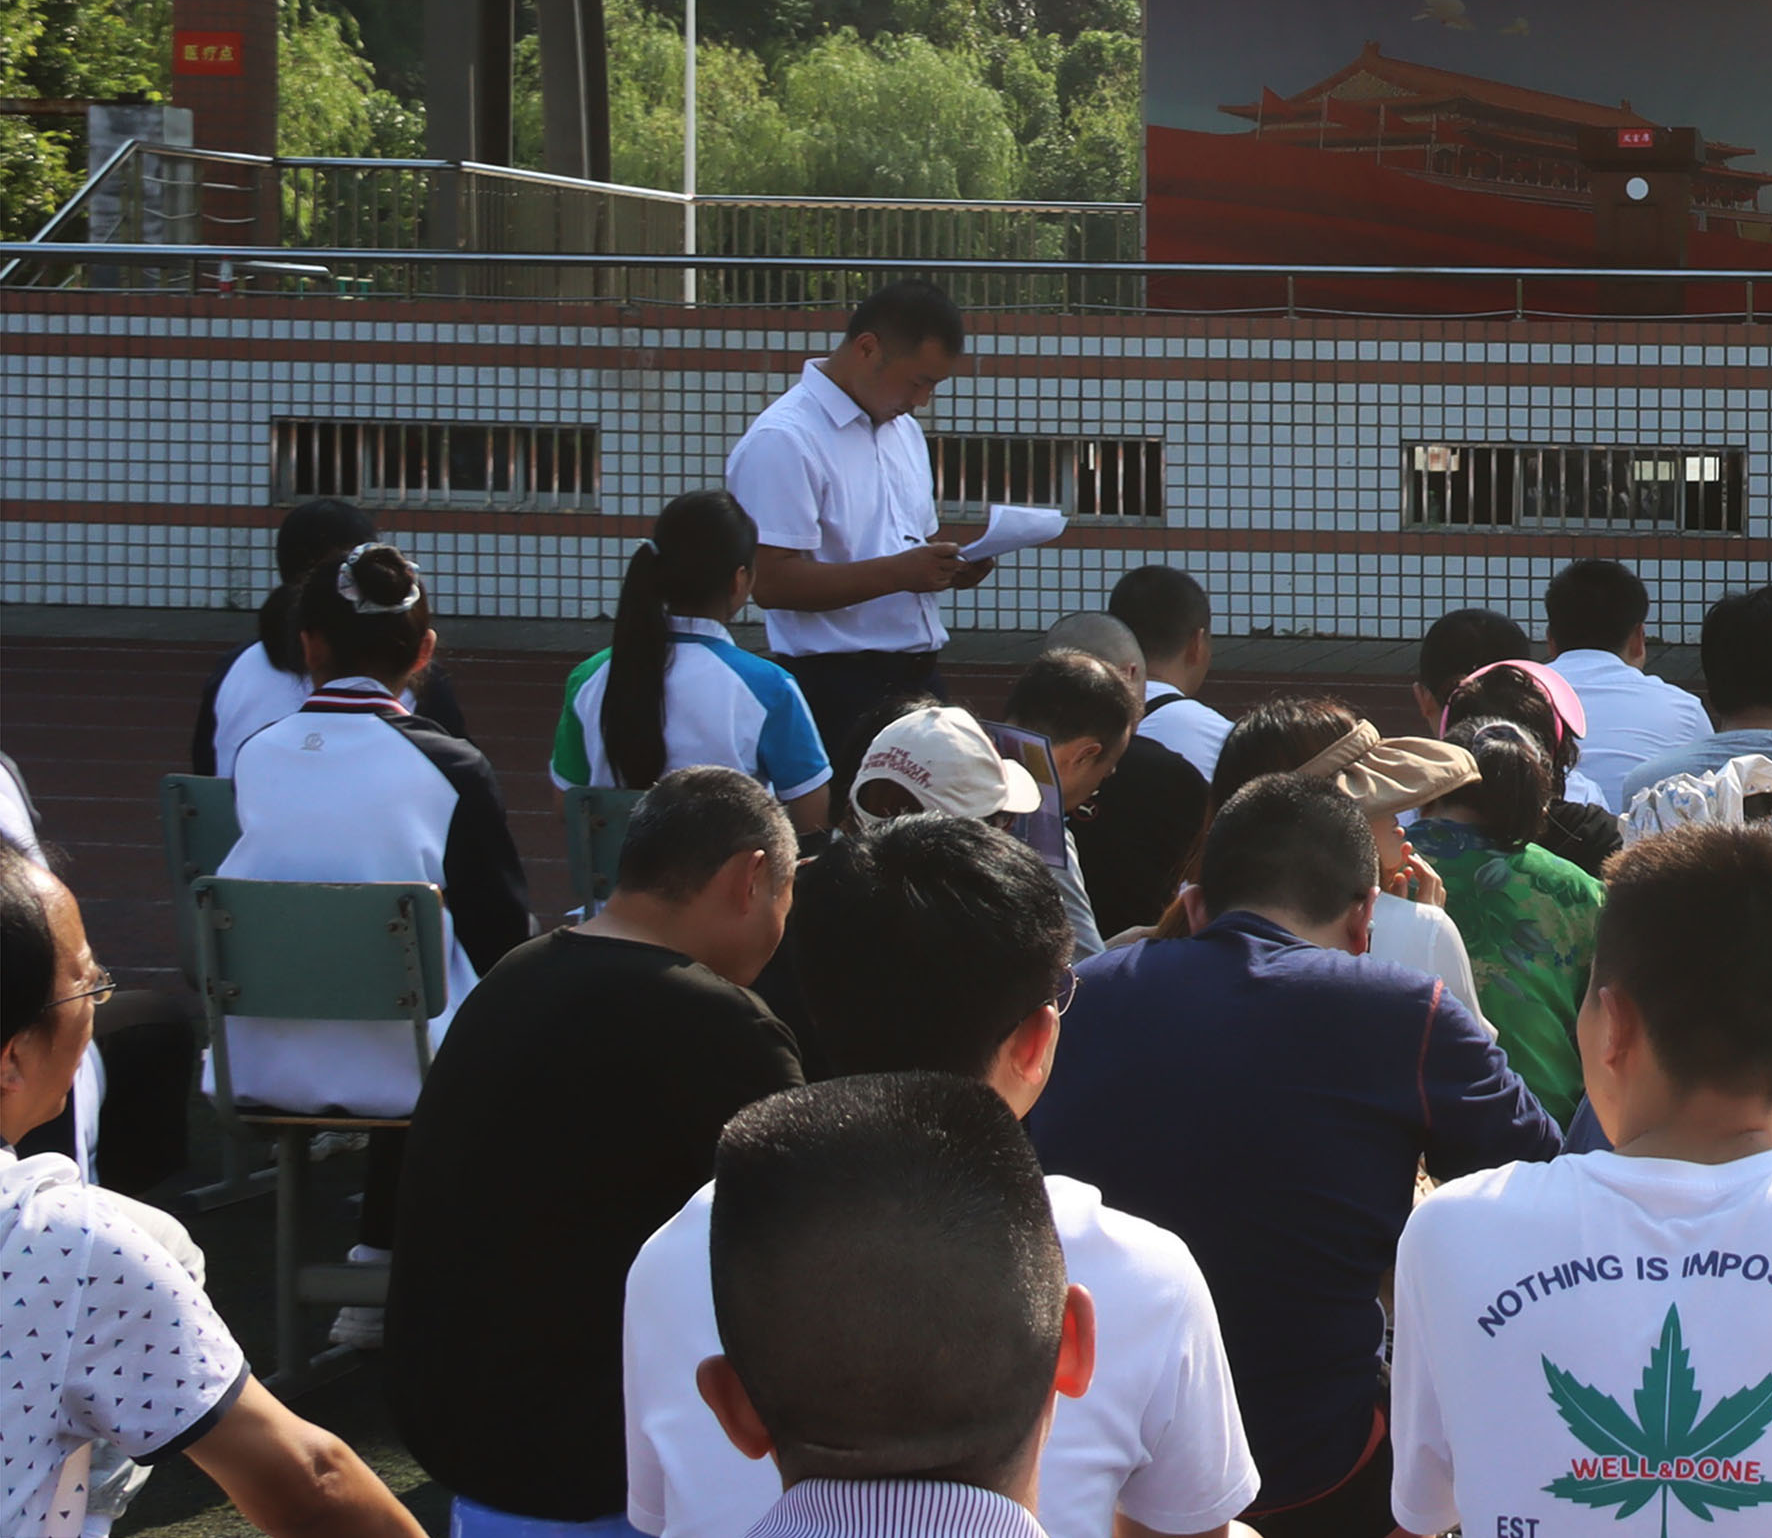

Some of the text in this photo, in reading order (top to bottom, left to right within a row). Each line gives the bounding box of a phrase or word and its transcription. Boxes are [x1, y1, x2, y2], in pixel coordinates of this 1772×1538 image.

[1477, 1254, 1624, 1338] NOTHING
[1636, 1256, 1669, 1281] IS
[1497, 1515, 1540, 1538] EST
